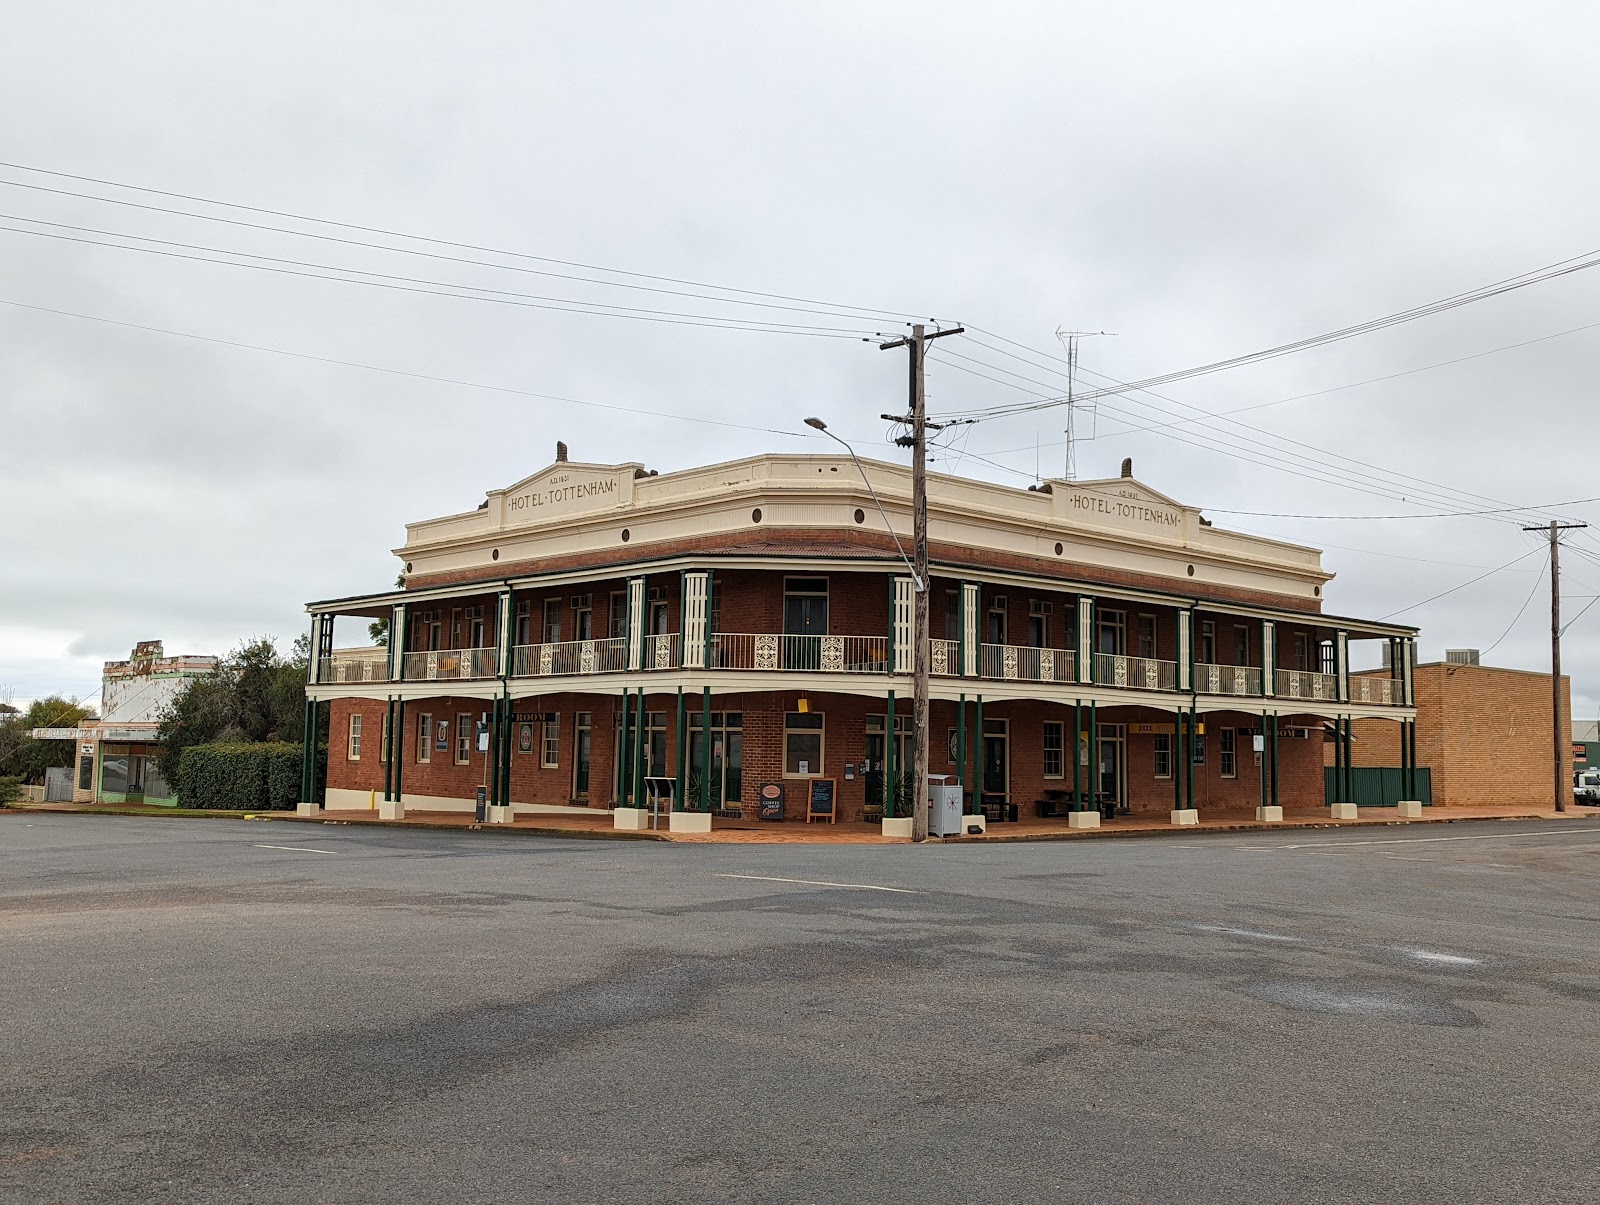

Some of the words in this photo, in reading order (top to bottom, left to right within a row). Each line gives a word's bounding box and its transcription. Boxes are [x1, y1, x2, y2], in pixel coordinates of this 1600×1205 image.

[511, 493, 544, 510] HOTEL
[548, 479, 614, 503] TOTTENHAM
[1074, 494, 1112, 514] HOTEL
[1116, 502, 1178, 526] TOTTENHAM
[515, 713, 546, 722] ROOM
